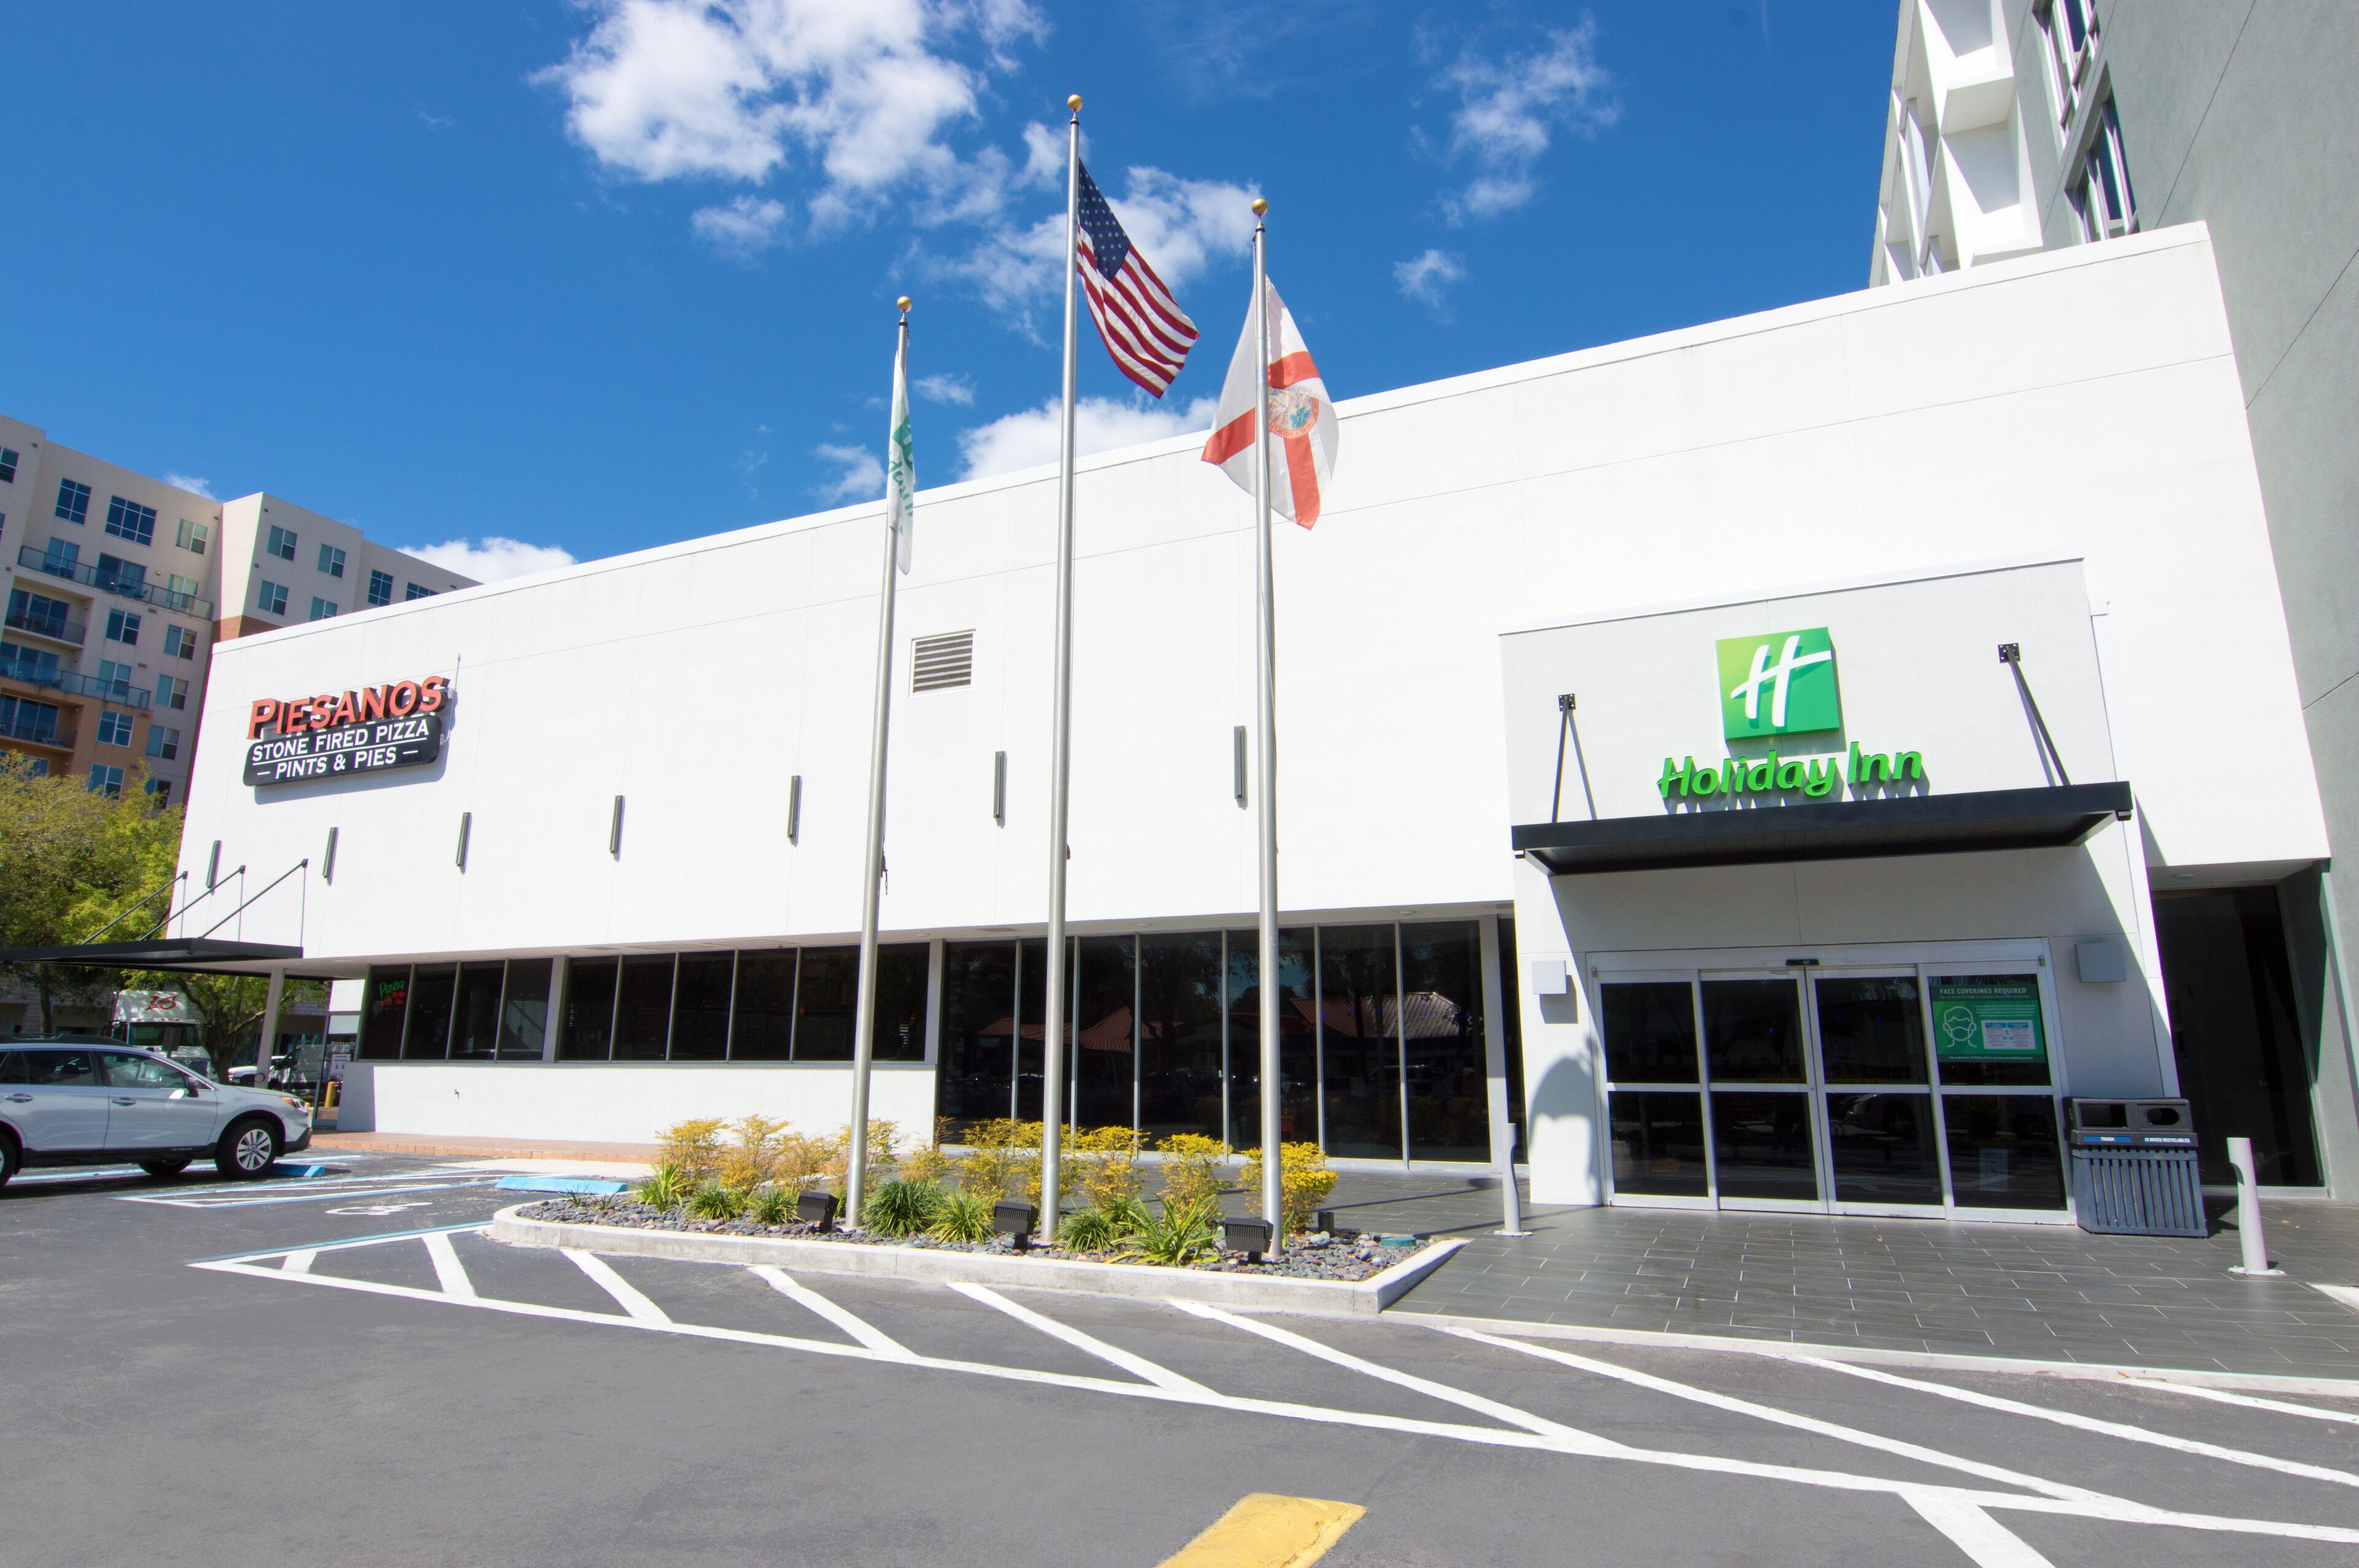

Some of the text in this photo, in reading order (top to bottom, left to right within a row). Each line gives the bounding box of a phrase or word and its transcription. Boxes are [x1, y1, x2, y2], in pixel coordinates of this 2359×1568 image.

[246, 676, 449, 739] PIESANOS
[252, 719, 429, 762] STONE FIRED PIZZA
[275, 747, 397, 779] PINTS & PIES
[1657, 741, 1923, 798] Holiday Inn
